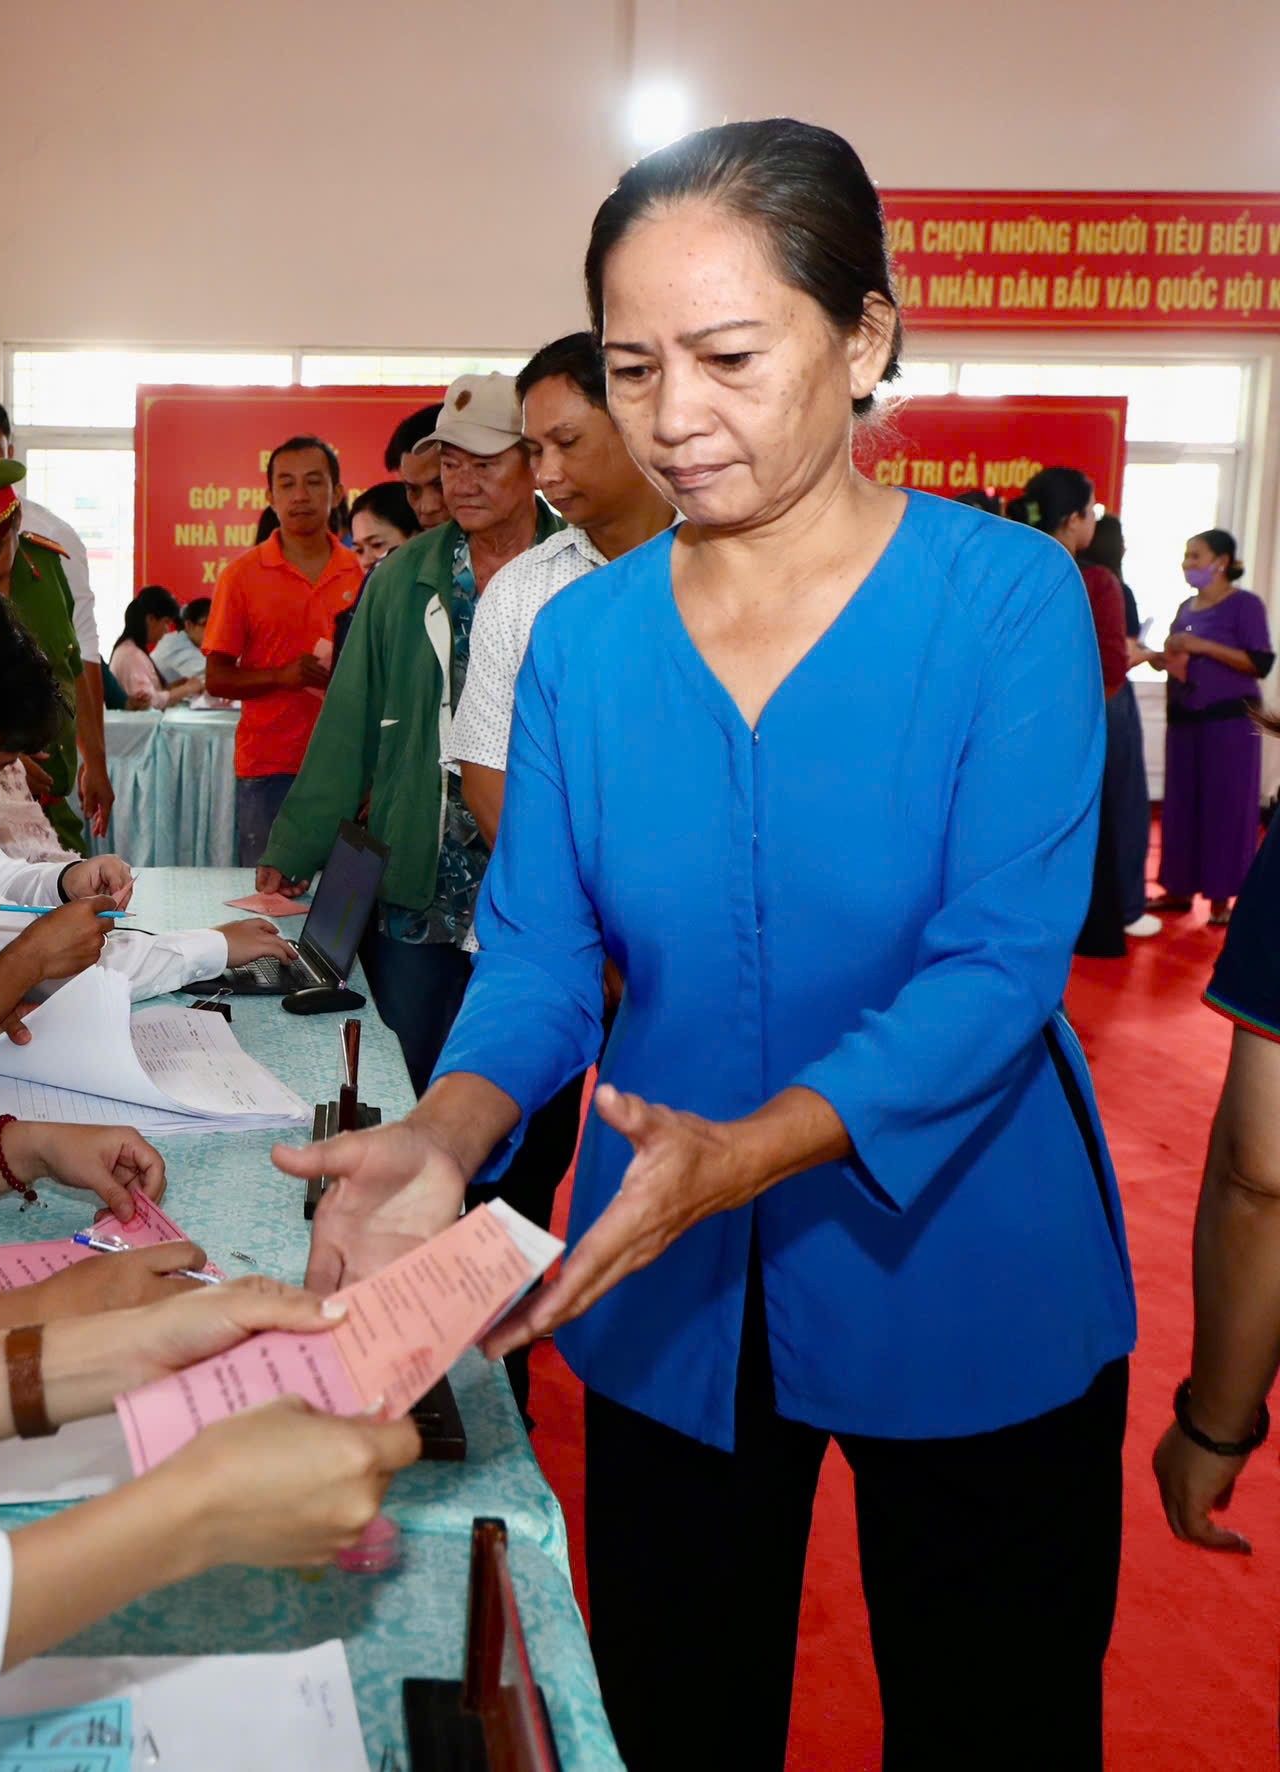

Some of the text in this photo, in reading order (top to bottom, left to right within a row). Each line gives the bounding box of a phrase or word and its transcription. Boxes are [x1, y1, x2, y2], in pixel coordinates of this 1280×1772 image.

[922, 219, 986, 261] CHỌN
[991, 215, 1071, 254] NHỮNG
[1076, 213, 1149, 255] NGƯỜI
[1155, 215, 1205, 255] TIÊU
[1208, 209, 1263, 255] BIỂU
[929, 268, 994, 308] NHÂN
[999, 268, 1048, 309] DÂN
[1106, 270, 1152, 309] VÀO
[1156, 265, 1219, 313] QUỐC
[1224, 270, 1264, 318] HỘI
[911, 460, 945, 487] TRI
[949, 452, 979, 488] CẢ
[189, 483, 232, 510] GÓP
[175, 519, 219, 547] NHÀ
